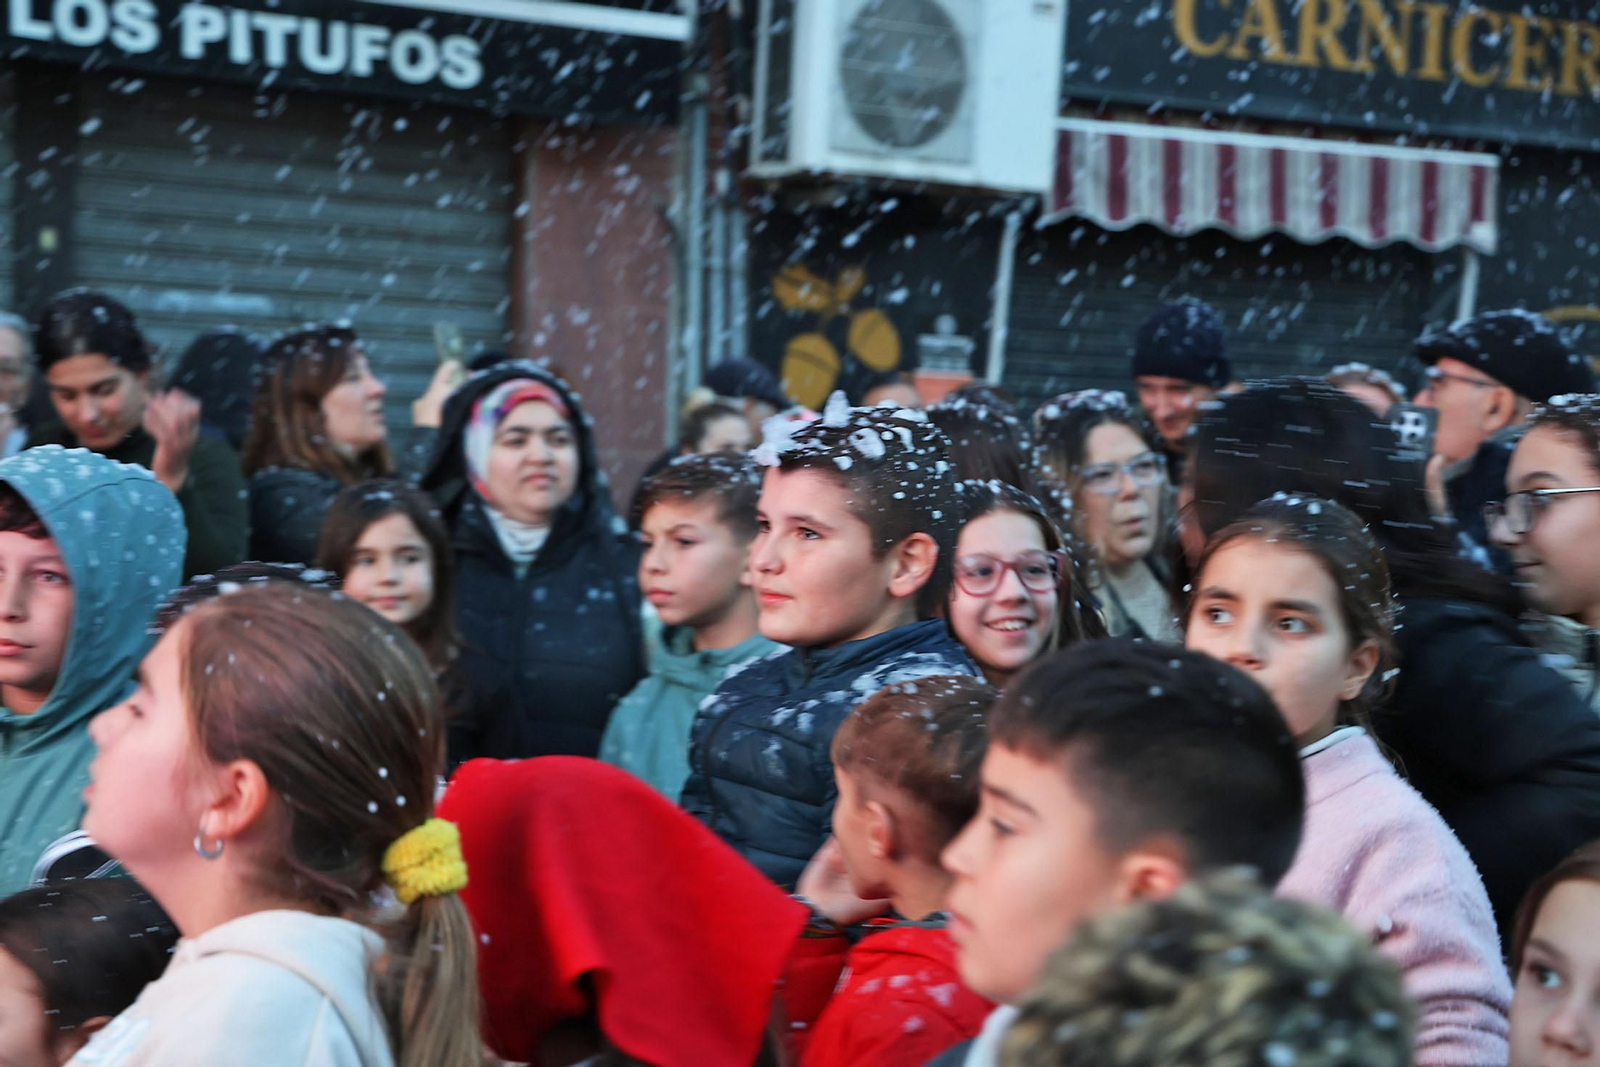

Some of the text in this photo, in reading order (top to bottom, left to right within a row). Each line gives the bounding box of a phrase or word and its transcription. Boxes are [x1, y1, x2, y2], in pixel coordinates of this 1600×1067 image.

[8, 0, 484, 90] LOS PITUFOS
[1173, 0, 1600, 95] CARNICER
